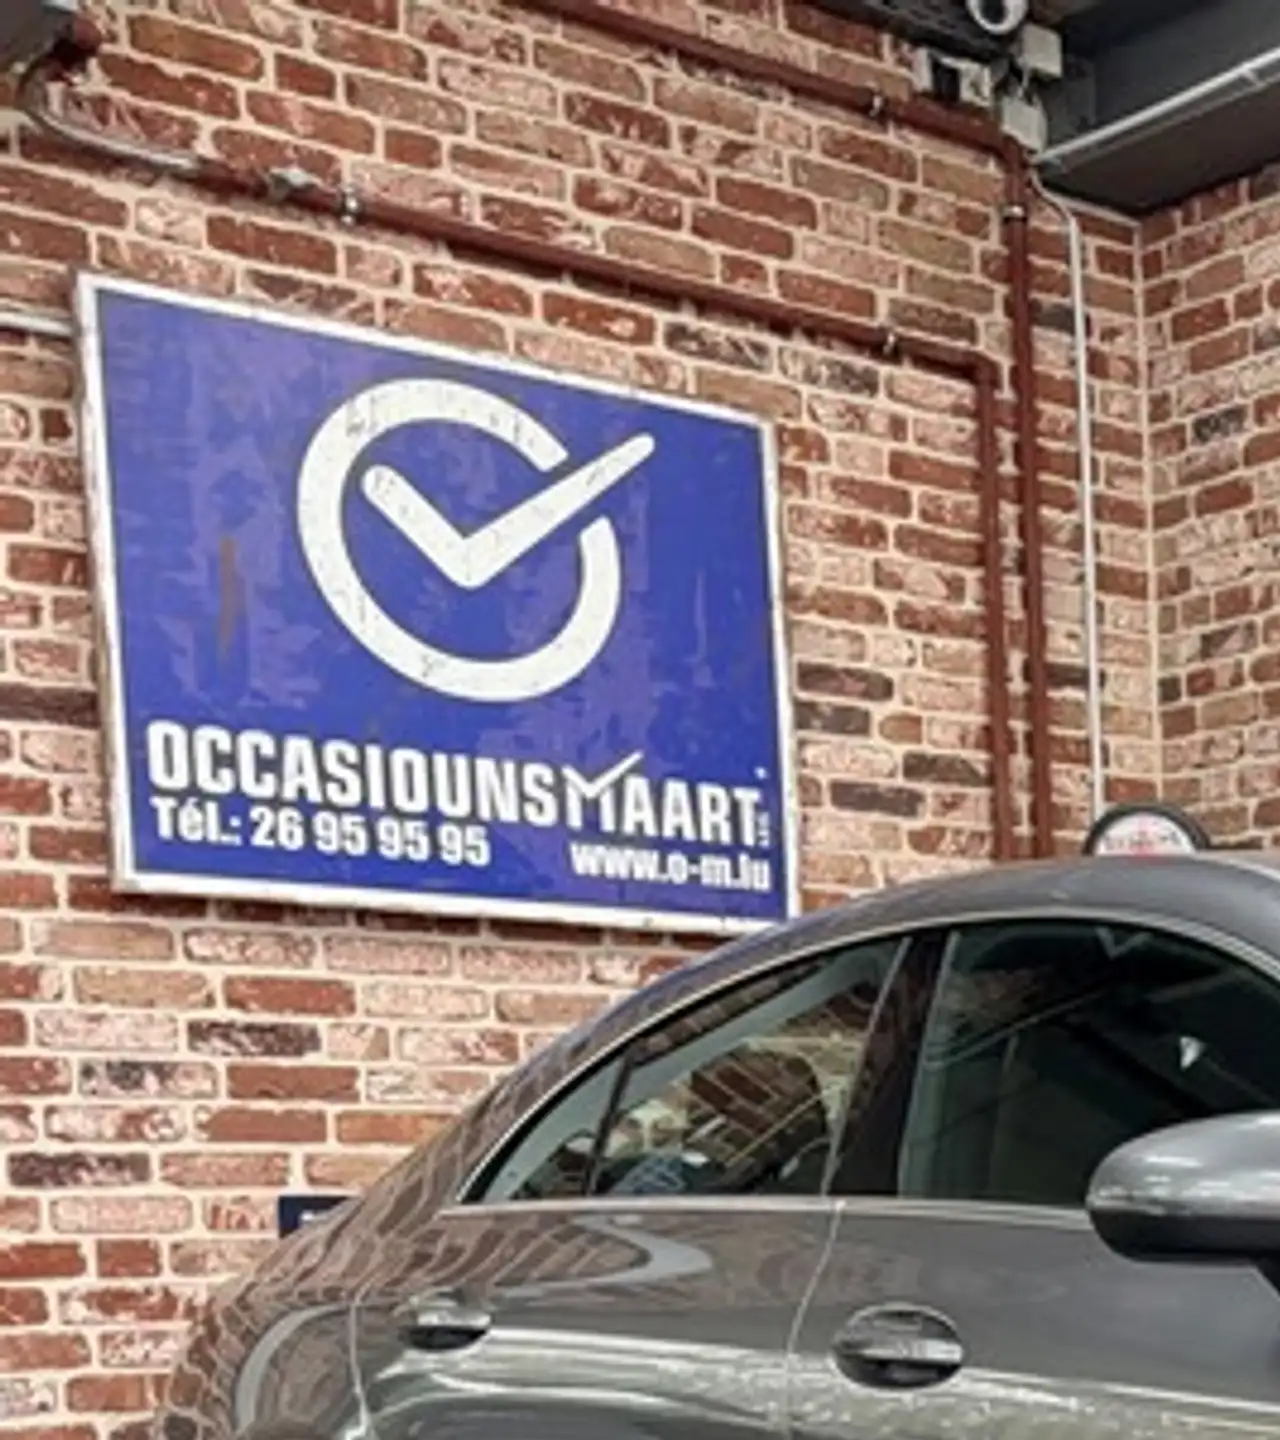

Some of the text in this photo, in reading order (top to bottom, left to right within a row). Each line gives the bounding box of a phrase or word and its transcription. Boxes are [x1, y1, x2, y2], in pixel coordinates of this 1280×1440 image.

[147, 719, 762, 847] OCCASIOUNSMAART
[249, 804, 305, 851] 26
[313, 810, 369, 856] 95
[376, 815, 431, 862] 95
[438, 823, 492, 868] 95
[569, 840, 772, 893] www.o-m.lu
